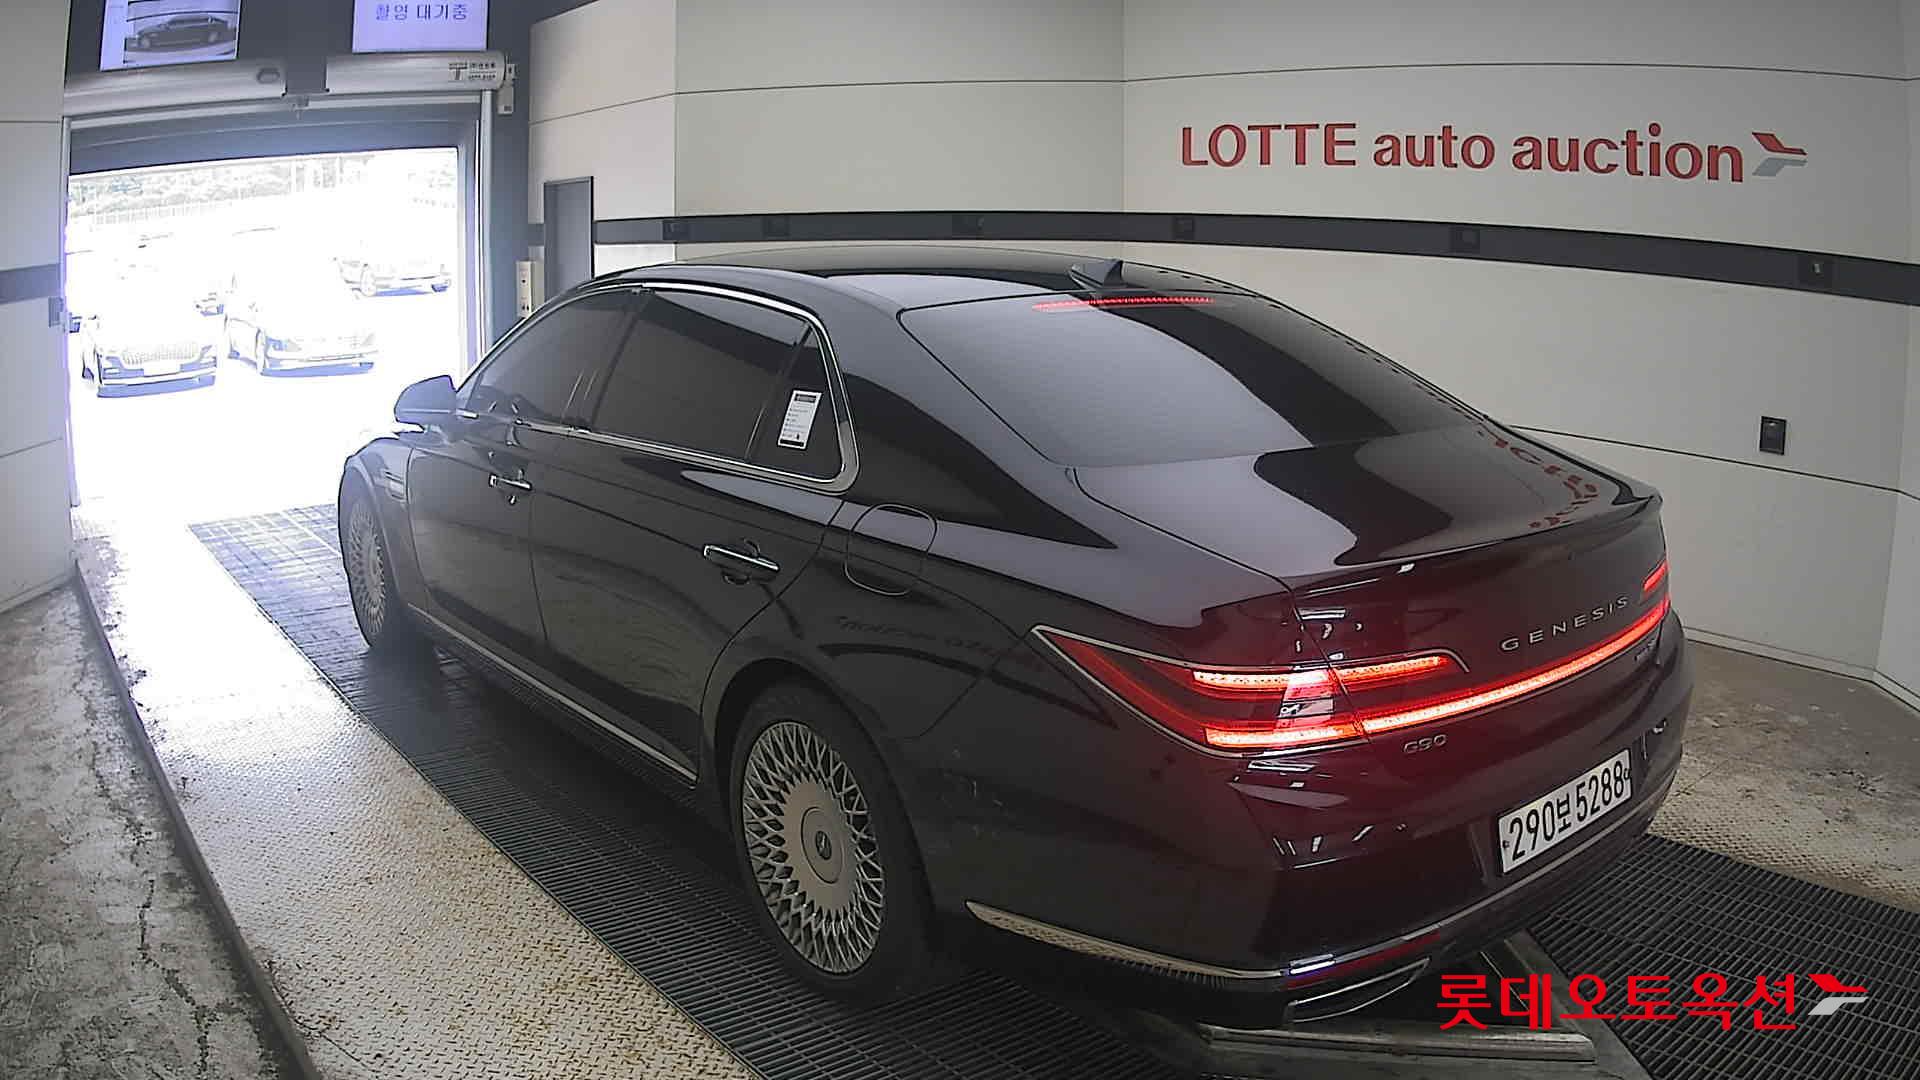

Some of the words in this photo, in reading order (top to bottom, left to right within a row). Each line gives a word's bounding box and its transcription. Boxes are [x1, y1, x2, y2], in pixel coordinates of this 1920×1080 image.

[416, 3, 469, 21] 대기중
[1182, 123, 1357, 166] LOTTE
[1373, 125, 1495, 169] auto
[1512, 122, 1745, 182] auction
[1500, 595, 1629, 652] GENESIS
[1403, 733, 1448, 754] G90
